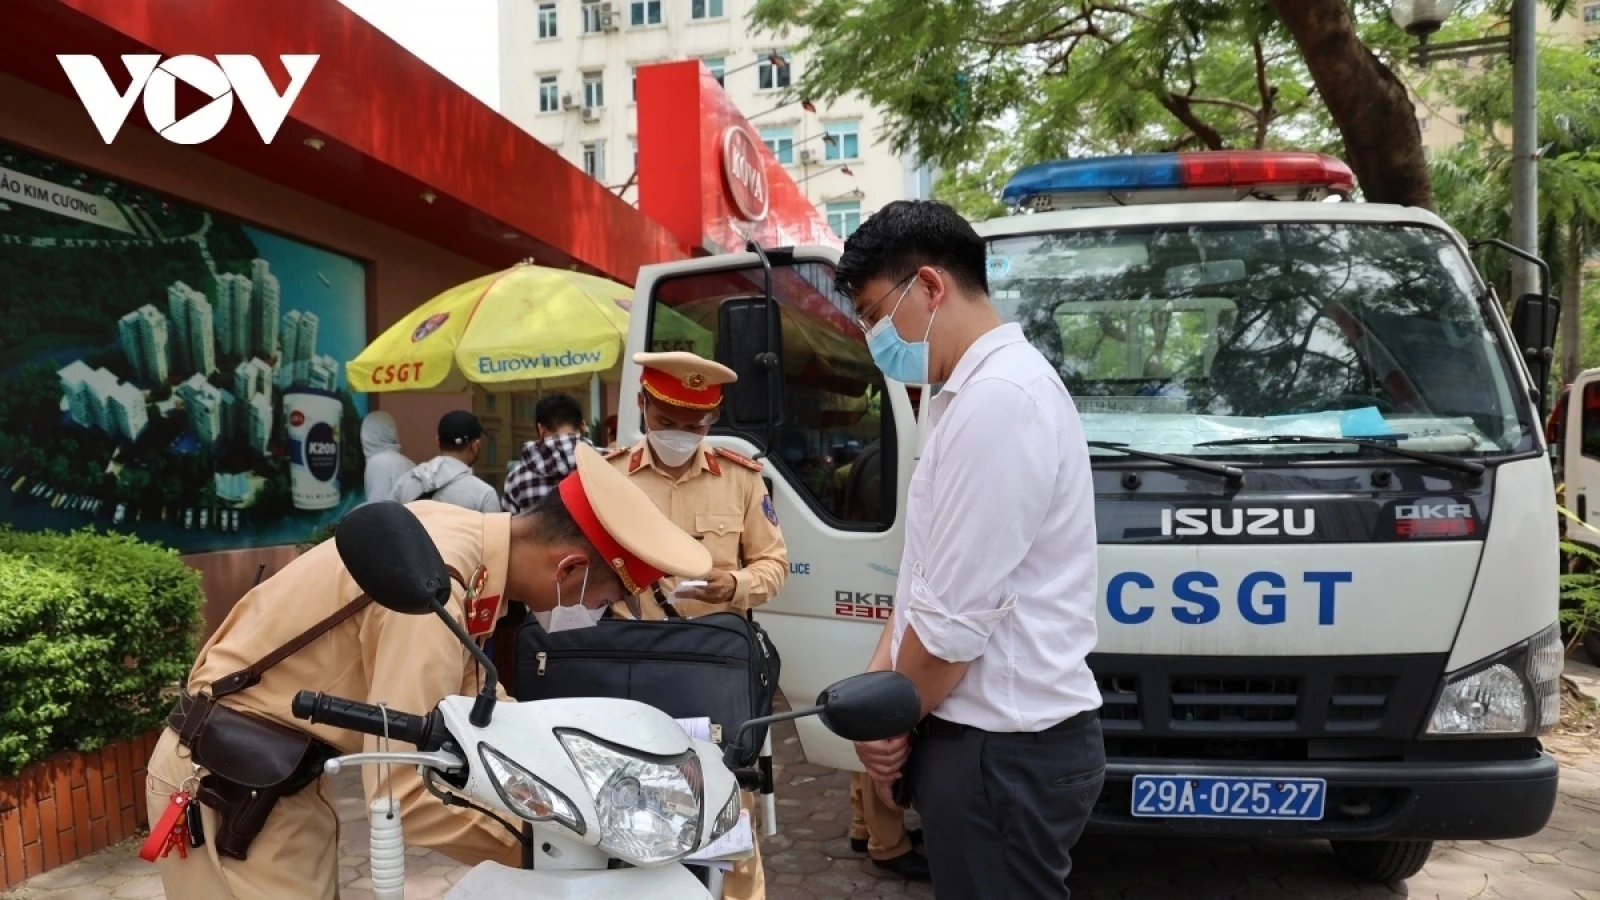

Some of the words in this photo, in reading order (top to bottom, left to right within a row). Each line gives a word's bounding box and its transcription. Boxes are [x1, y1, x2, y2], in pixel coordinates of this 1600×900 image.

[731, 143, 764, 204] KOVA
[0, 173, 21, 193] ẢO
[23, 183, 49, 202] KIM
[51, 193, 98, 216] CƯƠNG
[371, 361, 424, 384] CSGT
[478, 350, 602, 374] Eurowindow
[1161, 508, 1316, 536] ISUZU
[1395, 504, 1473, 519] QKR
[790, 562, 811, 575] LICE
[835, 590, 894, 608] QKR
[1106, 571, 1353, 626] CSGT
[1136, 780, 1320, 816] 29A-025.27
